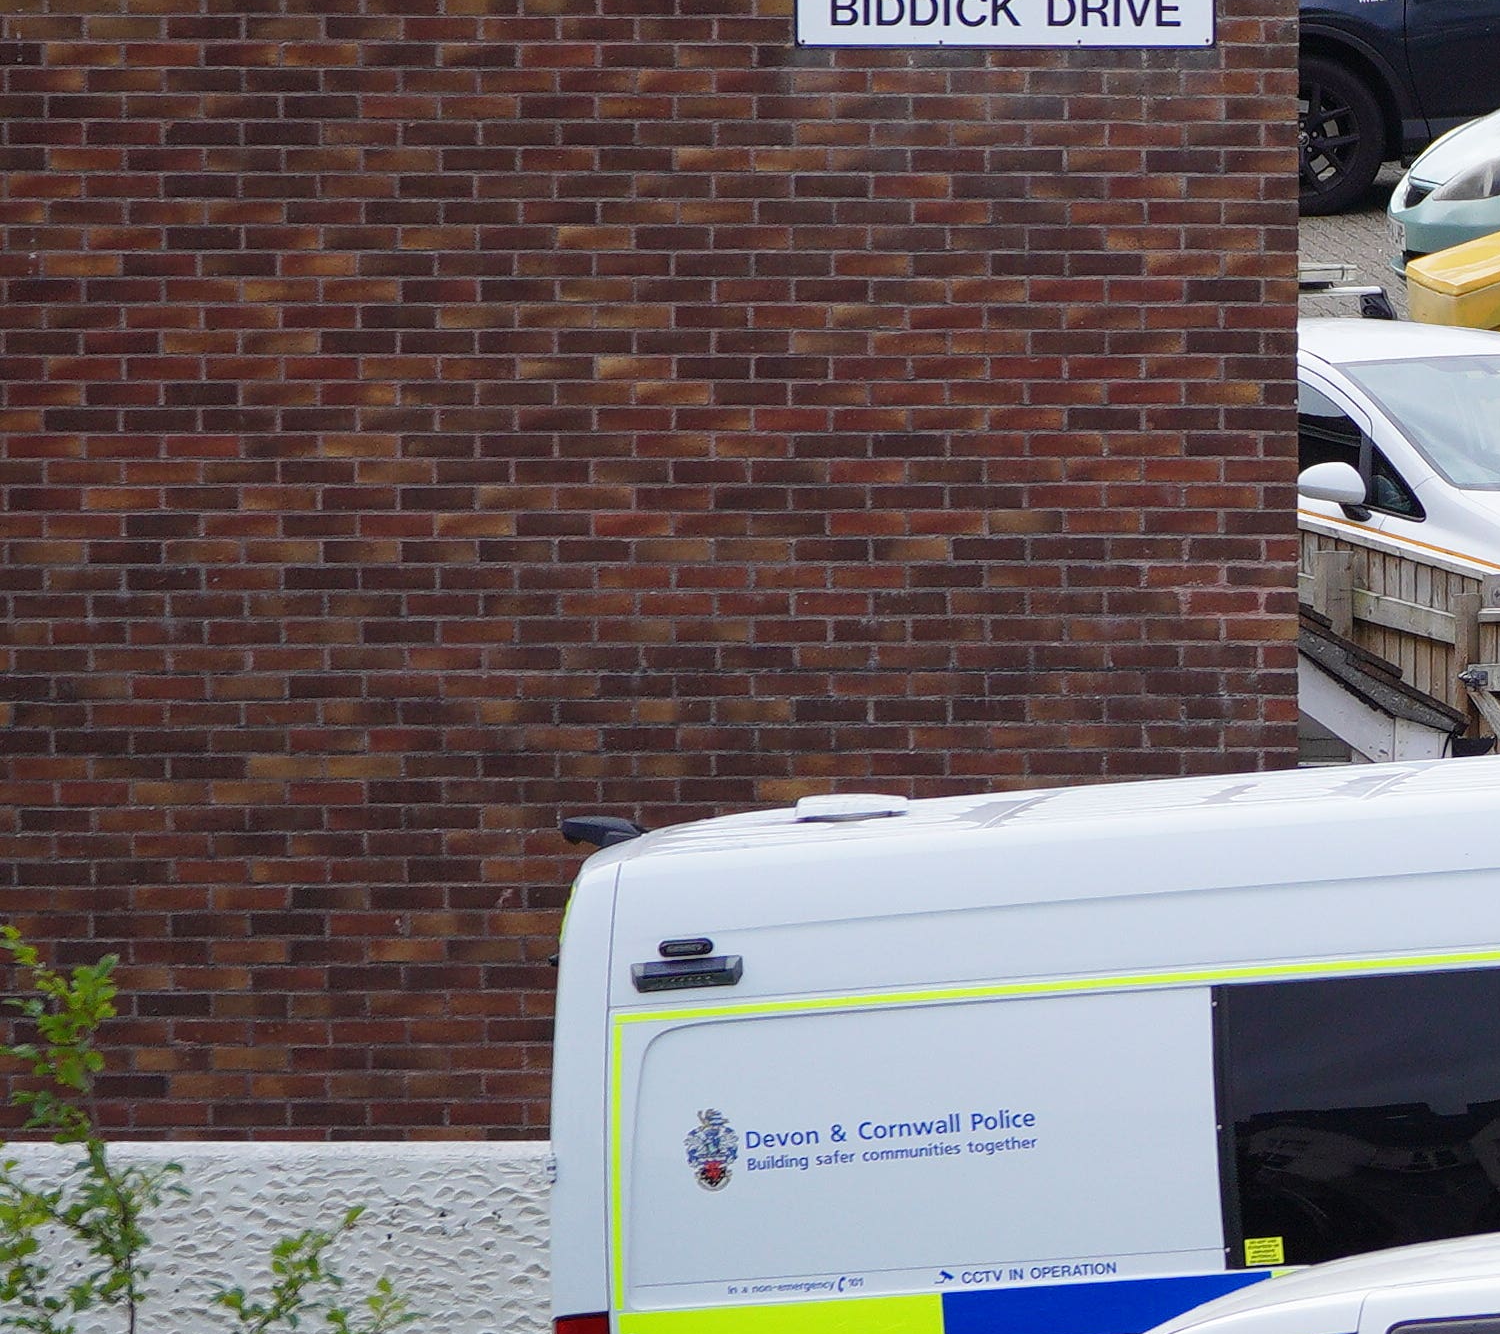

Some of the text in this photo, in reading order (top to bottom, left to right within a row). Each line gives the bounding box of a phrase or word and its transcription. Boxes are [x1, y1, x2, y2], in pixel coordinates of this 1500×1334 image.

[745, 1109, 1037, 1150] Devon & Cornwall Police
[747, 1136, 1038, 1172] Building safer communities together
[961, 1262, 1118, 1285] CCTV IN OPERATION
